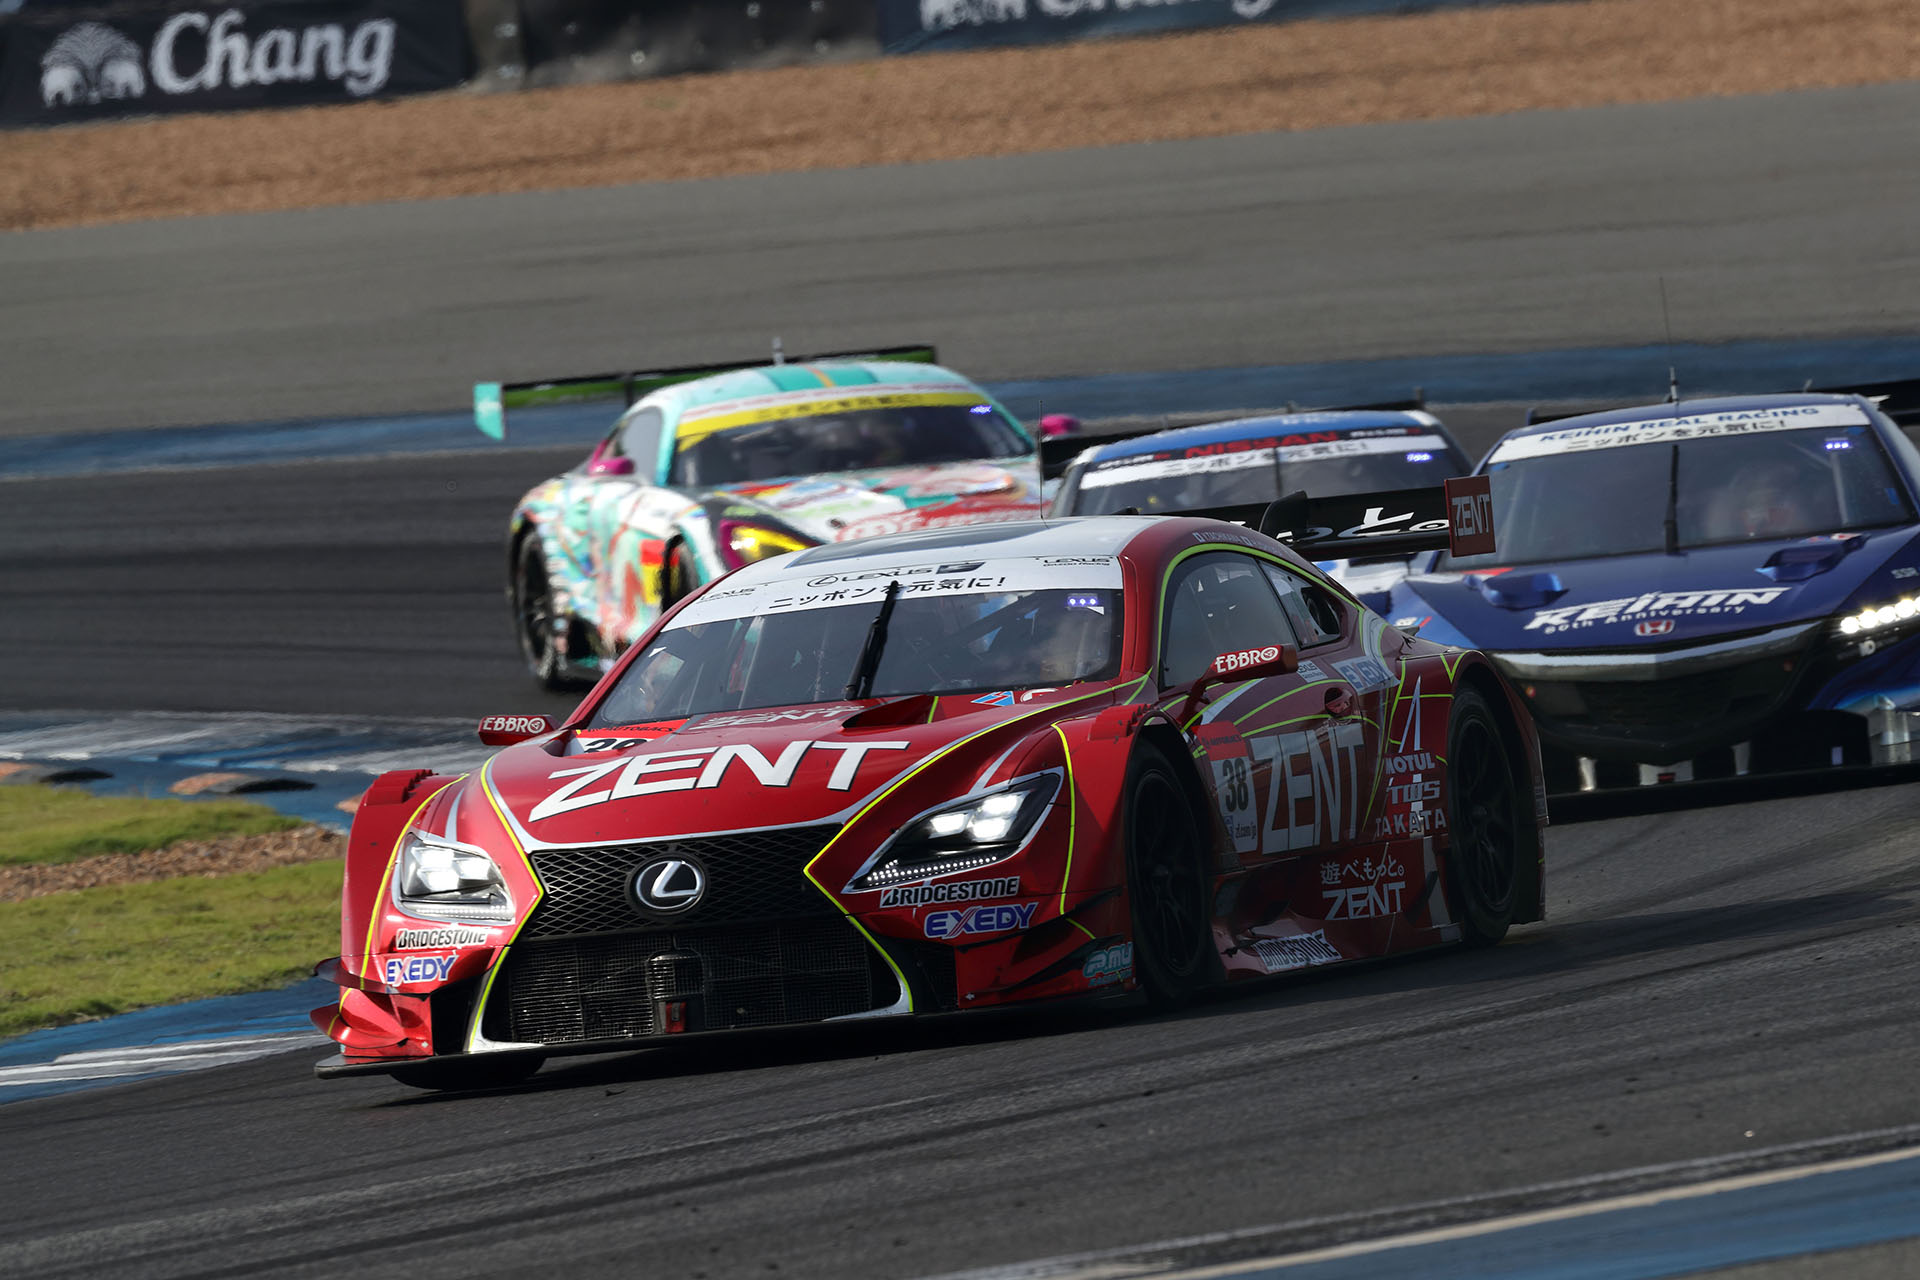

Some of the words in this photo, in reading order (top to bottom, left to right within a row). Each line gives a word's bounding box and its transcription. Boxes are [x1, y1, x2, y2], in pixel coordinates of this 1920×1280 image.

[149, 8, 396, 96] Chang
[1540, 425, 1629, 442] KEIHIN
[1640, 417, 1707, 430] REAL
[1717, 408, 1819, 422] RACING
[1185, 431, 1338, 458] NISSAN
[1451, 493, 1494, 538] ZENT
[841, 566, 933, 583] LEXUS
[1605, 604, 1745, 625] Anniversary
[1214, 645, 1280, 674] EBBRO
[482, 715, 546, 734] EBBRO
[1385, 752, 1436, 775] MOTUL
[528, 740, 911, 823] ZENT
[1222, 758, 1249, 812] 38
[1250, 723, 1365, 855] ZENT
[1375, 808, 1447, 837] TAKATA
[882, 877, 1019, 907] BRIDGESTONE
[1322, 881, 1406, 921] ZENT
[926, 903, 1037, 939] EXEDY
[397, 929, 488, 950] BRIDGESTONE
[386, 956, 456, 983] EXEDY
